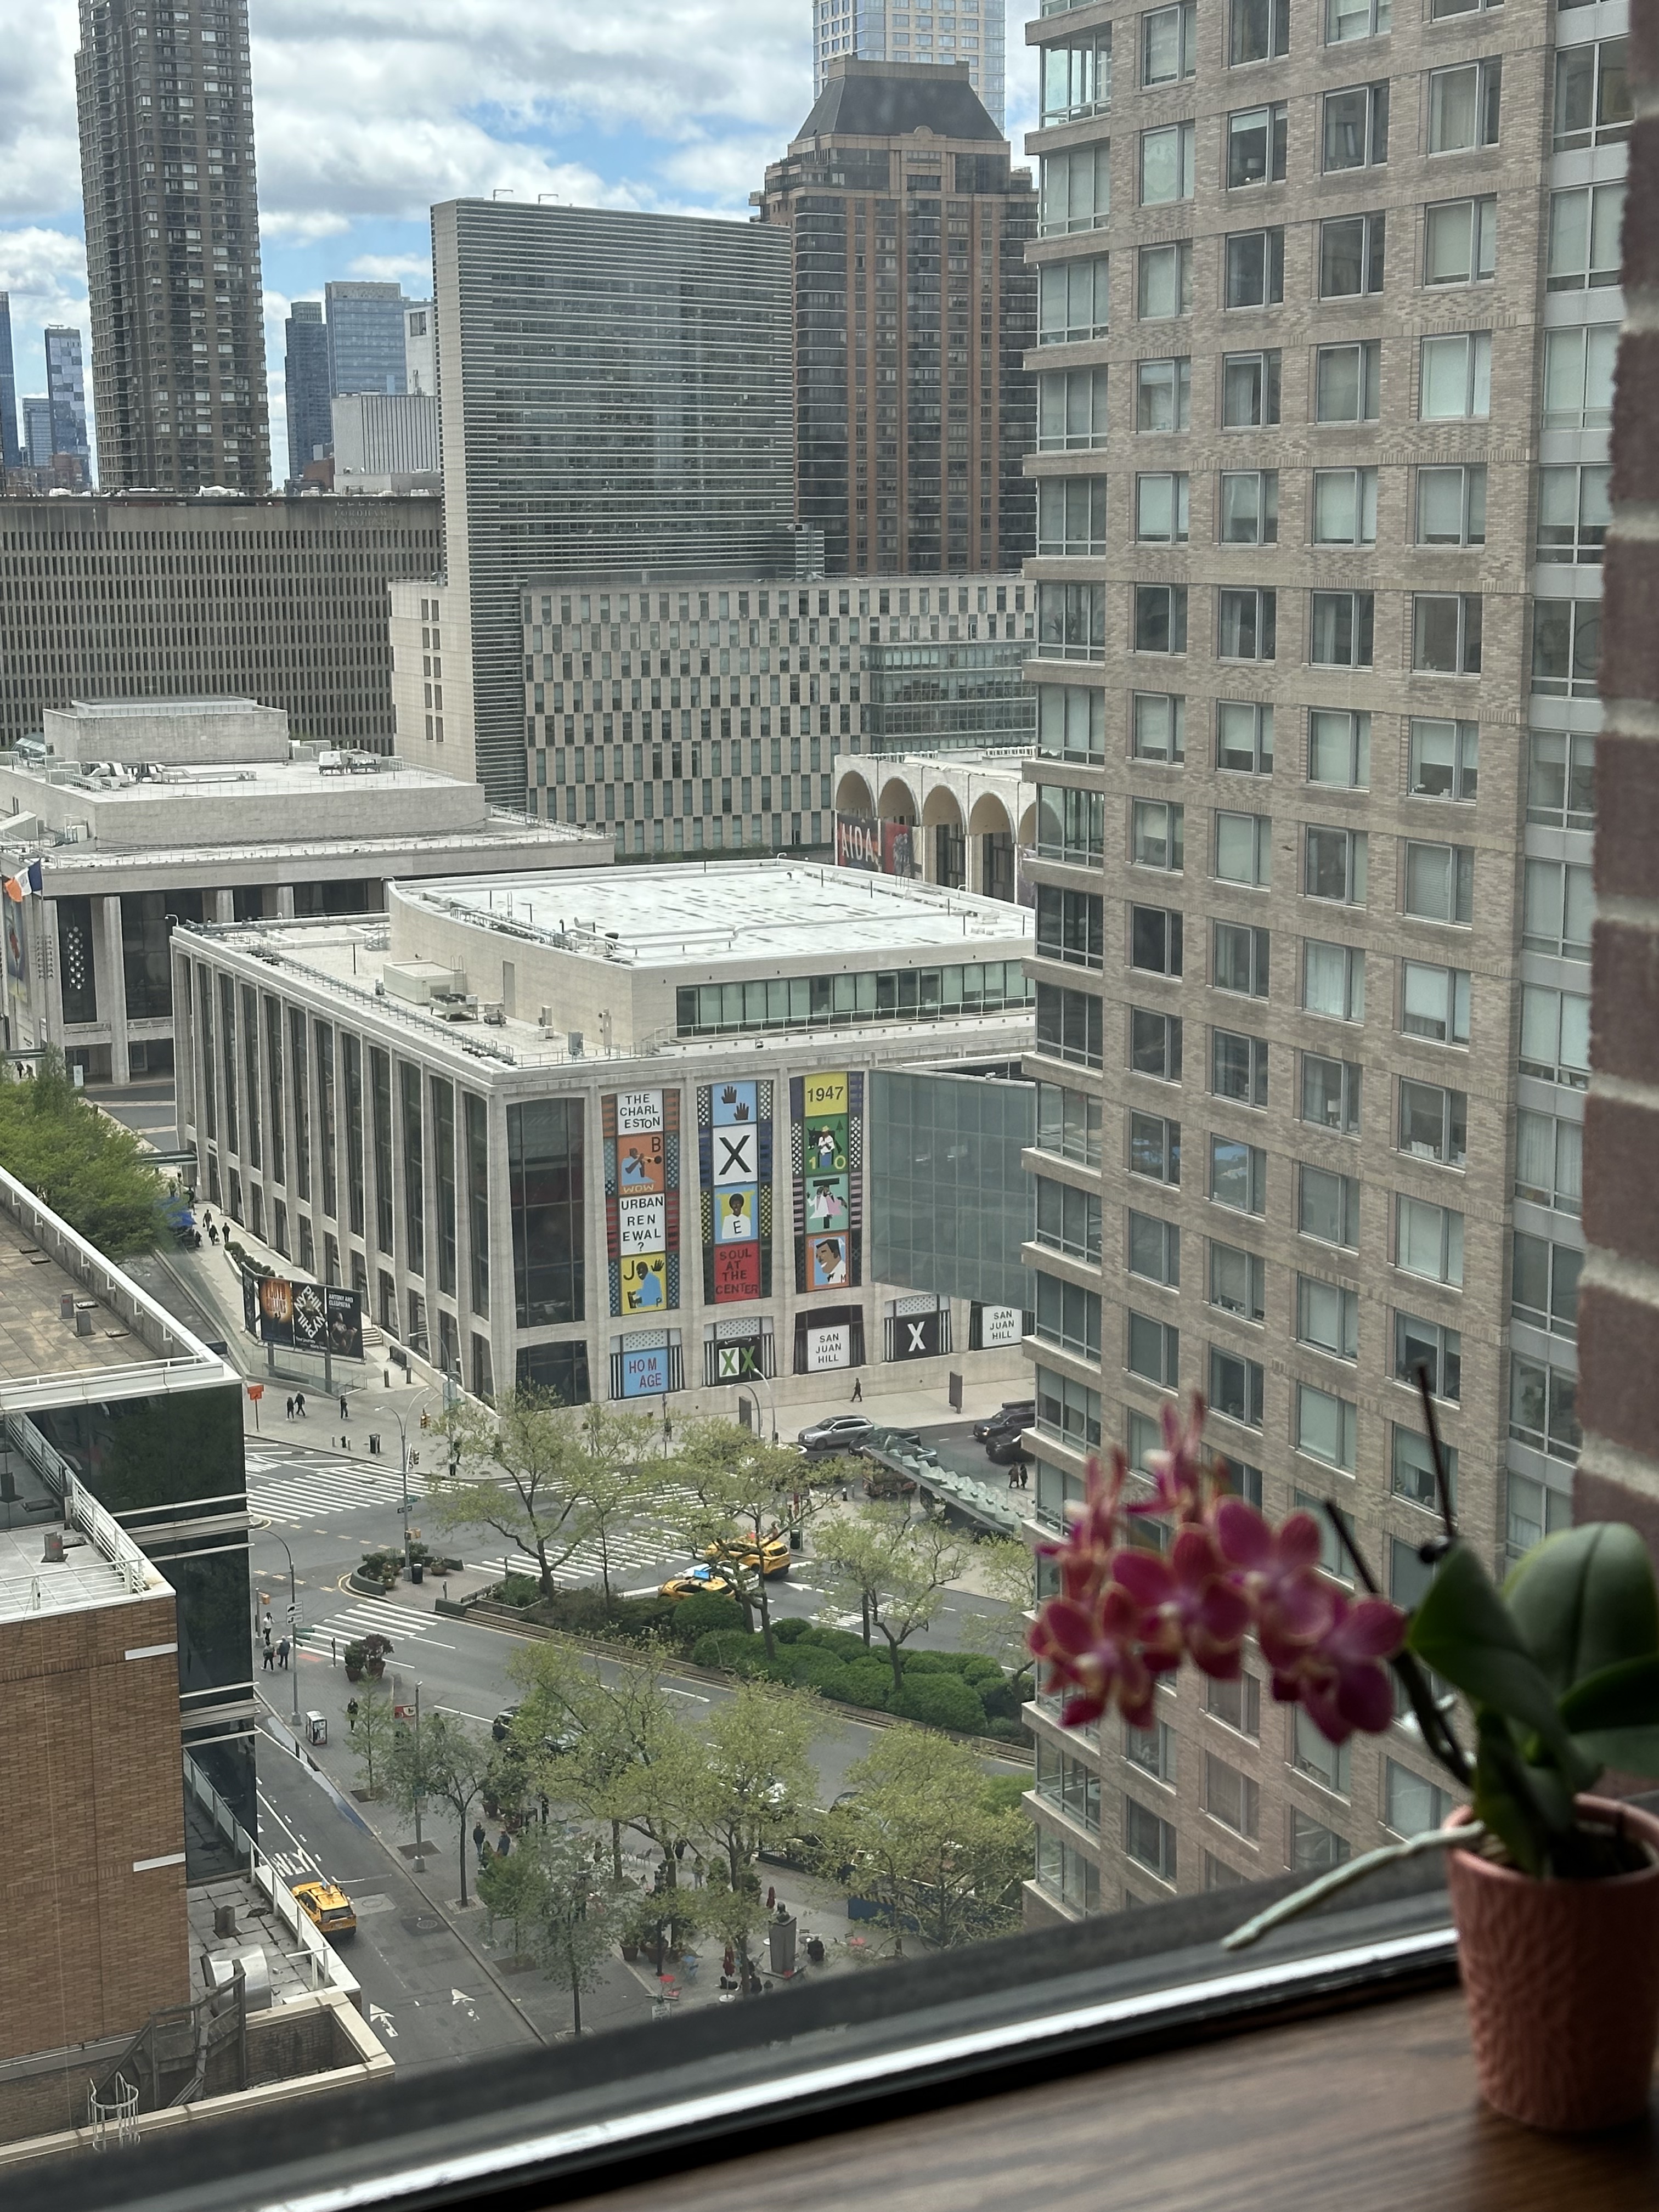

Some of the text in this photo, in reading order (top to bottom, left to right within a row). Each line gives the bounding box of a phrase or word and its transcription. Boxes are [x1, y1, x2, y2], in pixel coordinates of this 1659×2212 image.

[842, 823, 875, 862] AIDA
[625, 1093, 650, 1105] THE
[807, 1085, 844, 1102] 1947
[620, 1104, 658, 1116] CHARL
[624, 1116, 660, 1128] ESTON
[652, 1137, 661, 1153] B
[719, 1135, 752, 1176] X
[623, 1184, 654, 1194] WOW
[621, 1196, 663, 1210] URBAN
[628, 1214, 655, 1226] REN
[733, 1221, 742, 1234] E
[623, 1228, 661, 1242] EWAL
[637, 1242, 644, 1251] ?
[720, 1248, 752, 1260] SOUL
[623, 1260, 634, 1280] J
[726, 1260, 741, 1271] AT
[722, 1269, 747, 1282] THE
[715, 1284, 758, 1295] CENTER
[302, 1285, 322, 1312] PHIL
[994, 1310, 1012, 1320] SAN
[990, 1319, 1014, 1330] JUAN
[819, 1333, 839, 1343] SAN
[907, 1321, 926, 1352] X
[992, 1330, 1012, 1340] HILL
[815, 1342, 842, 1354] JUAN
[818, 1353, 839, 1364] HILL
[639, 1373, 662, 1389] AGE
